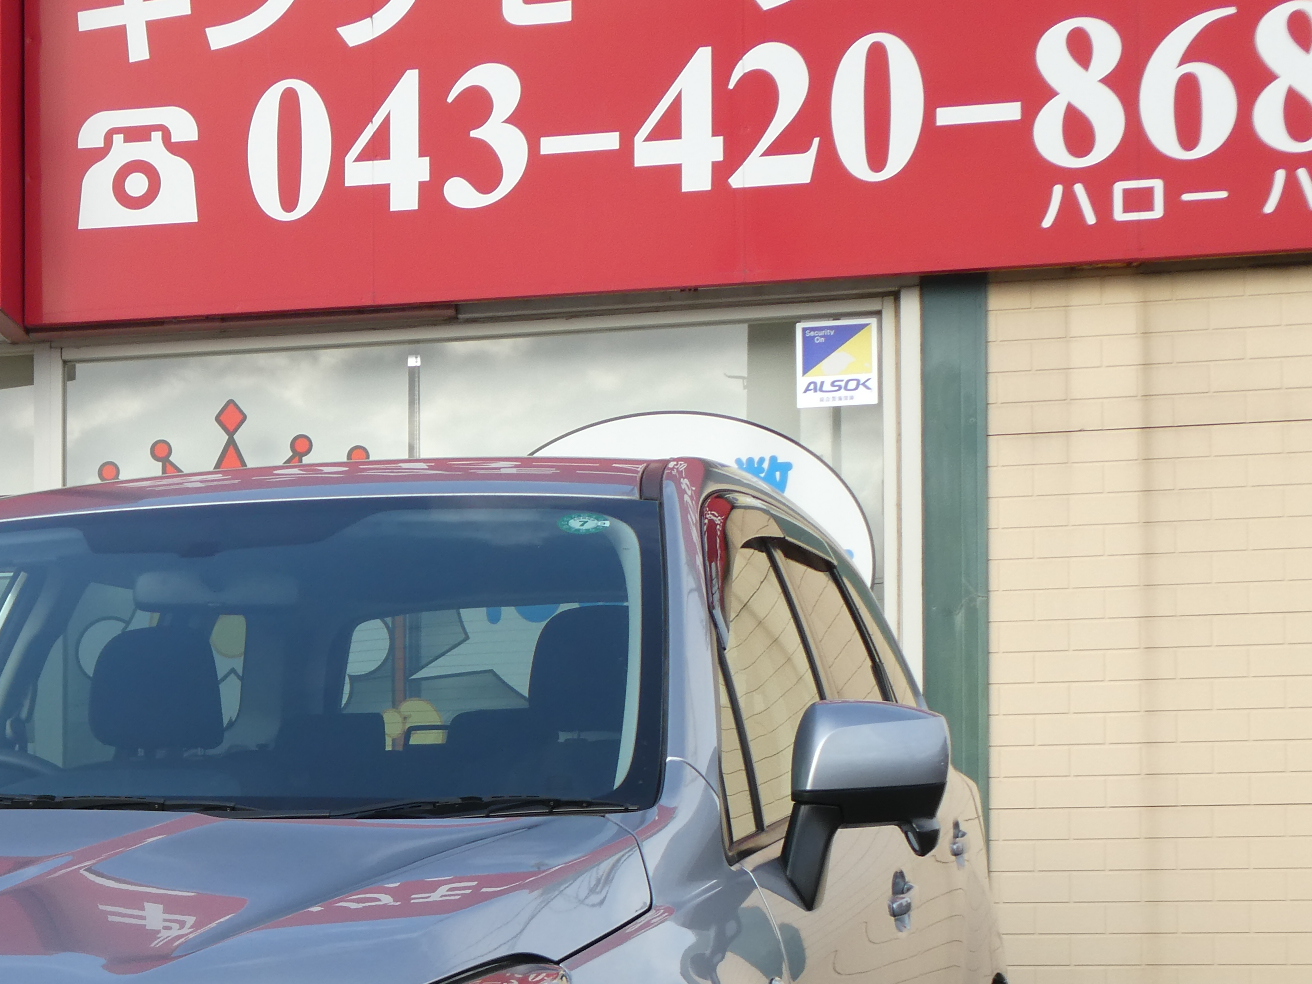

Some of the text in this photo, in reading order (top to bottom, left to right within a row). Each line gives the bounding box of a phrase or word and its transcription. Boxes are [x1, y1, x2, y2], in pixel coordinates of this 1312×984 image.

[805, 328, 835, 337] Security
[814, 336, 825, 344] On
[802, 377, 873, 394] ALSOK
